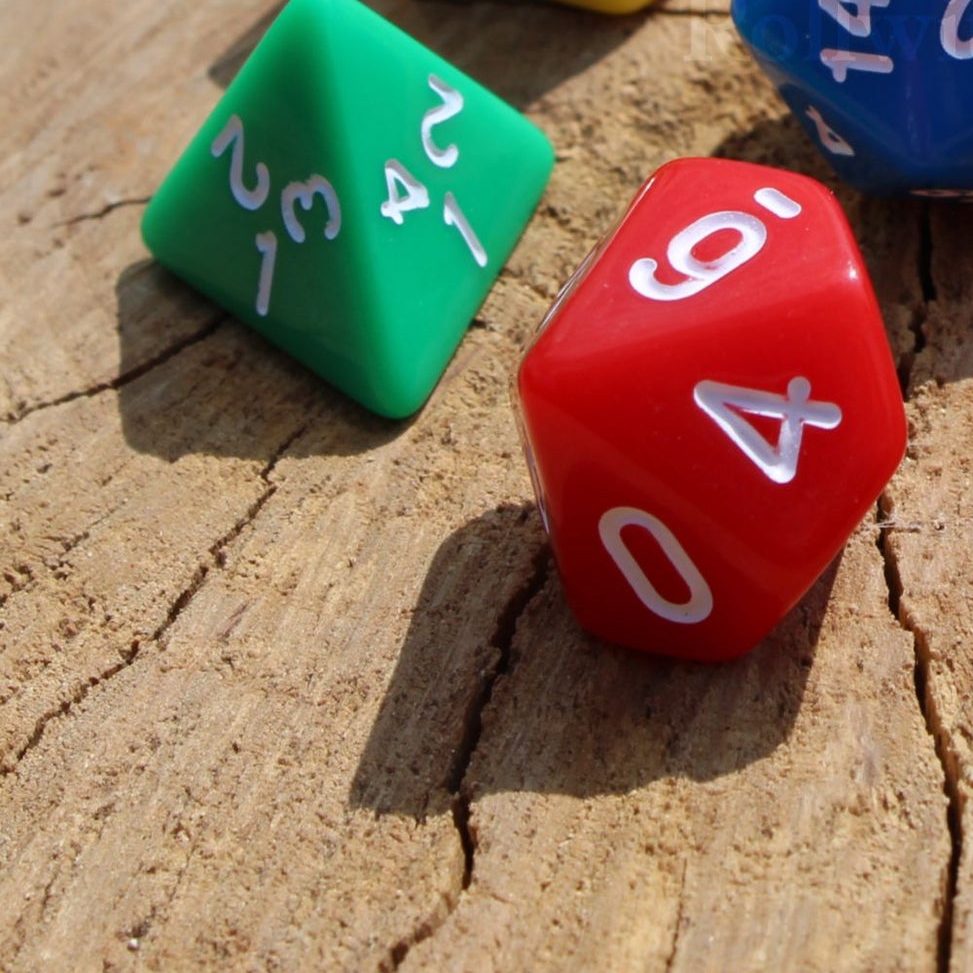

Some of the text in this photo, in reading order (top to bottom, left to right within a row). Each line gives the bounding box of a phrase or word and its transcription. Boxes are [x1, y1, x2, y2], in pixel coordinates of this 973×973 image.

[211, 114, 271, 210] 2
[421, 73, 463, 168] 2
[281, 173, 342, 244] 3
[380, 158, 430, 225] 4
[443, 191, 488, 268] 1
[255, 230, 278, 317] 1
[693, 375, 843, 485] 4
[598, 506, 714, 625] 0
